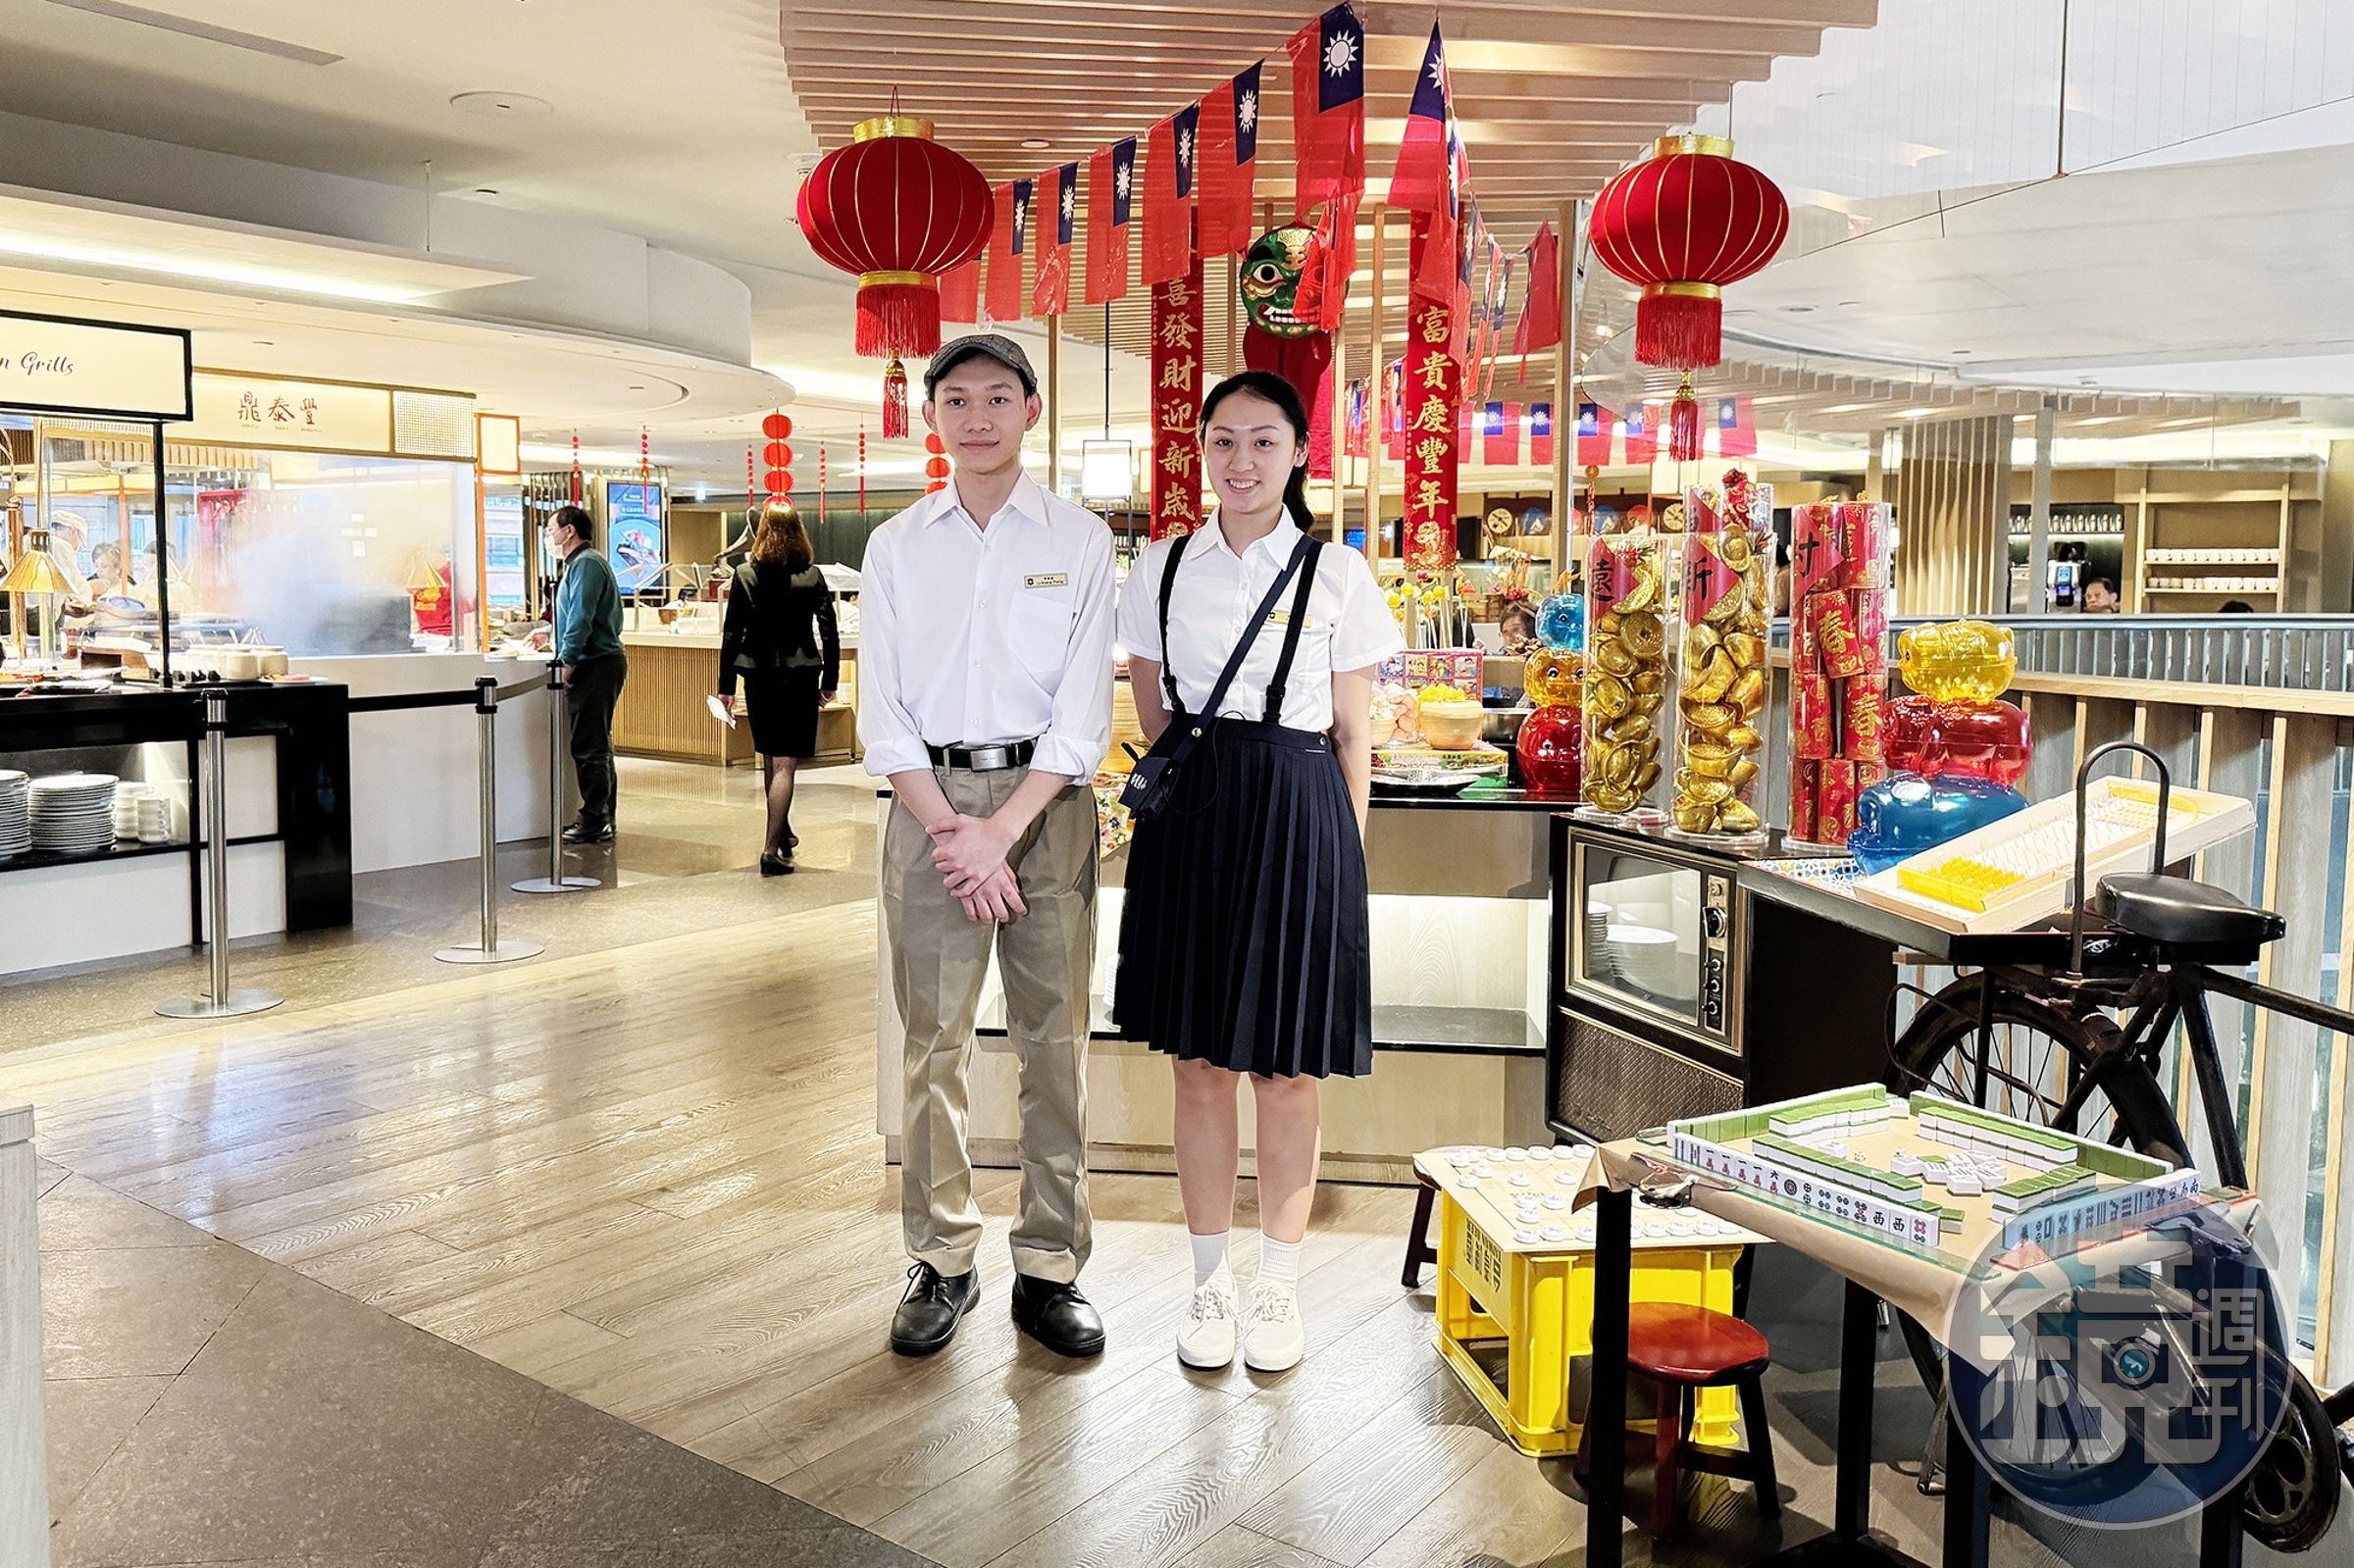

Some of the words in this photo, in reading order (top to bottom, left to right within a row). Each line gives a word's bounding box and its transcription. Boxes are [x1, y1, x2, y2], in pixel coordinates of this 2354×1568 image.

[21, 351, 75, 376] Grills
[1158, 247, 1199, 522] 喜發財迎新歲
[1414, 232, 1453, 520] 富貴慶豐年
[237, 391, 318, 425] 鼎泰豐
[1818, 609, 1857, 654] 春
[1850, 691, 1883, 737] 春
